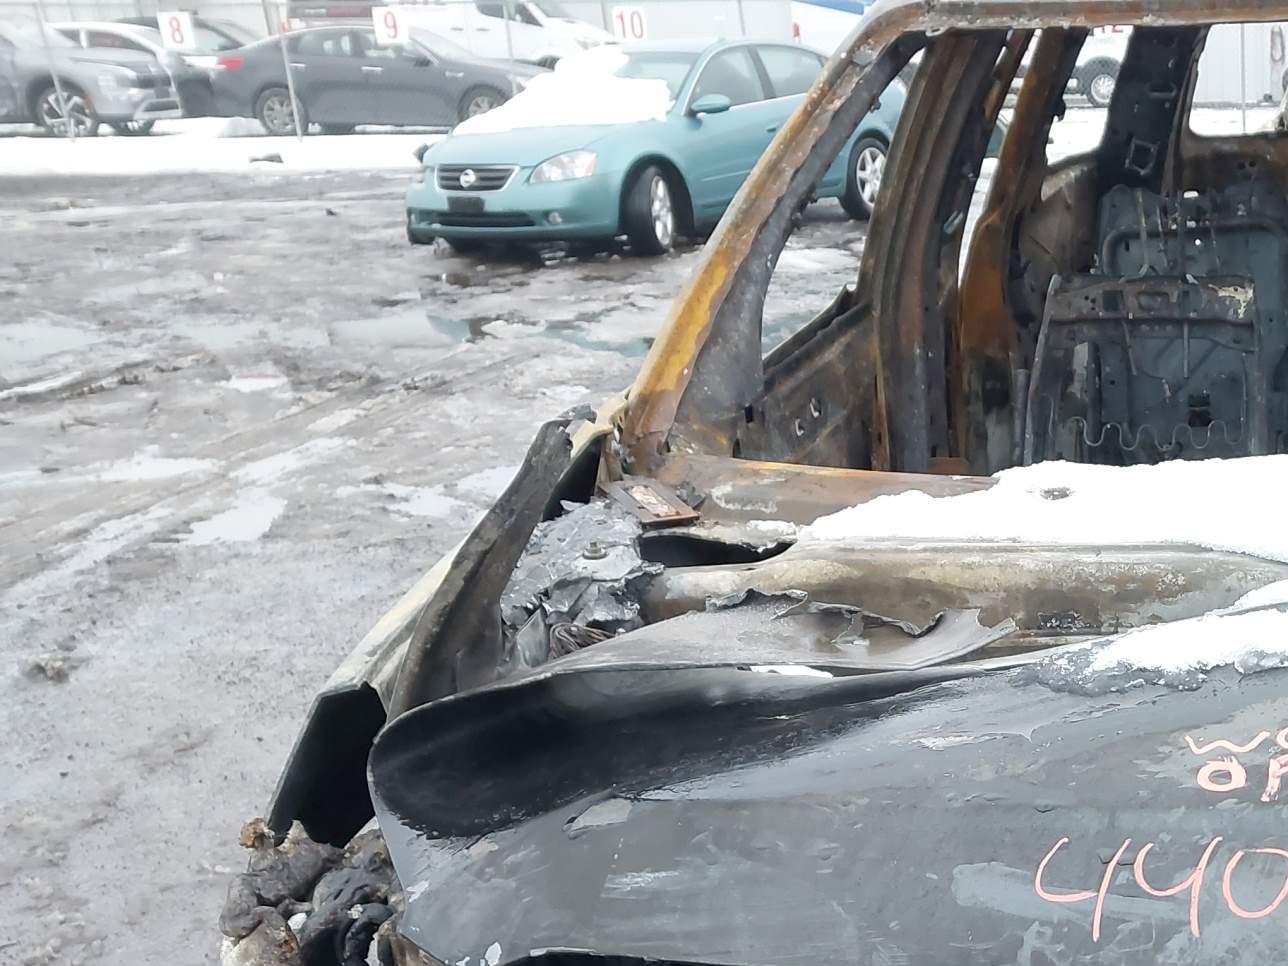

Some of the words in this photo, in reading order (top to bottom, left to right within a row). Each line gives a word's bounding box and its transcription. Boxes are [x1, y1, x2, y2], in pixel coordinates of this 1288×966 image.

[169, 16, 184, 44] 8
[383, 11, 398, 39] 9
[616, 10, 644, 39] 10
